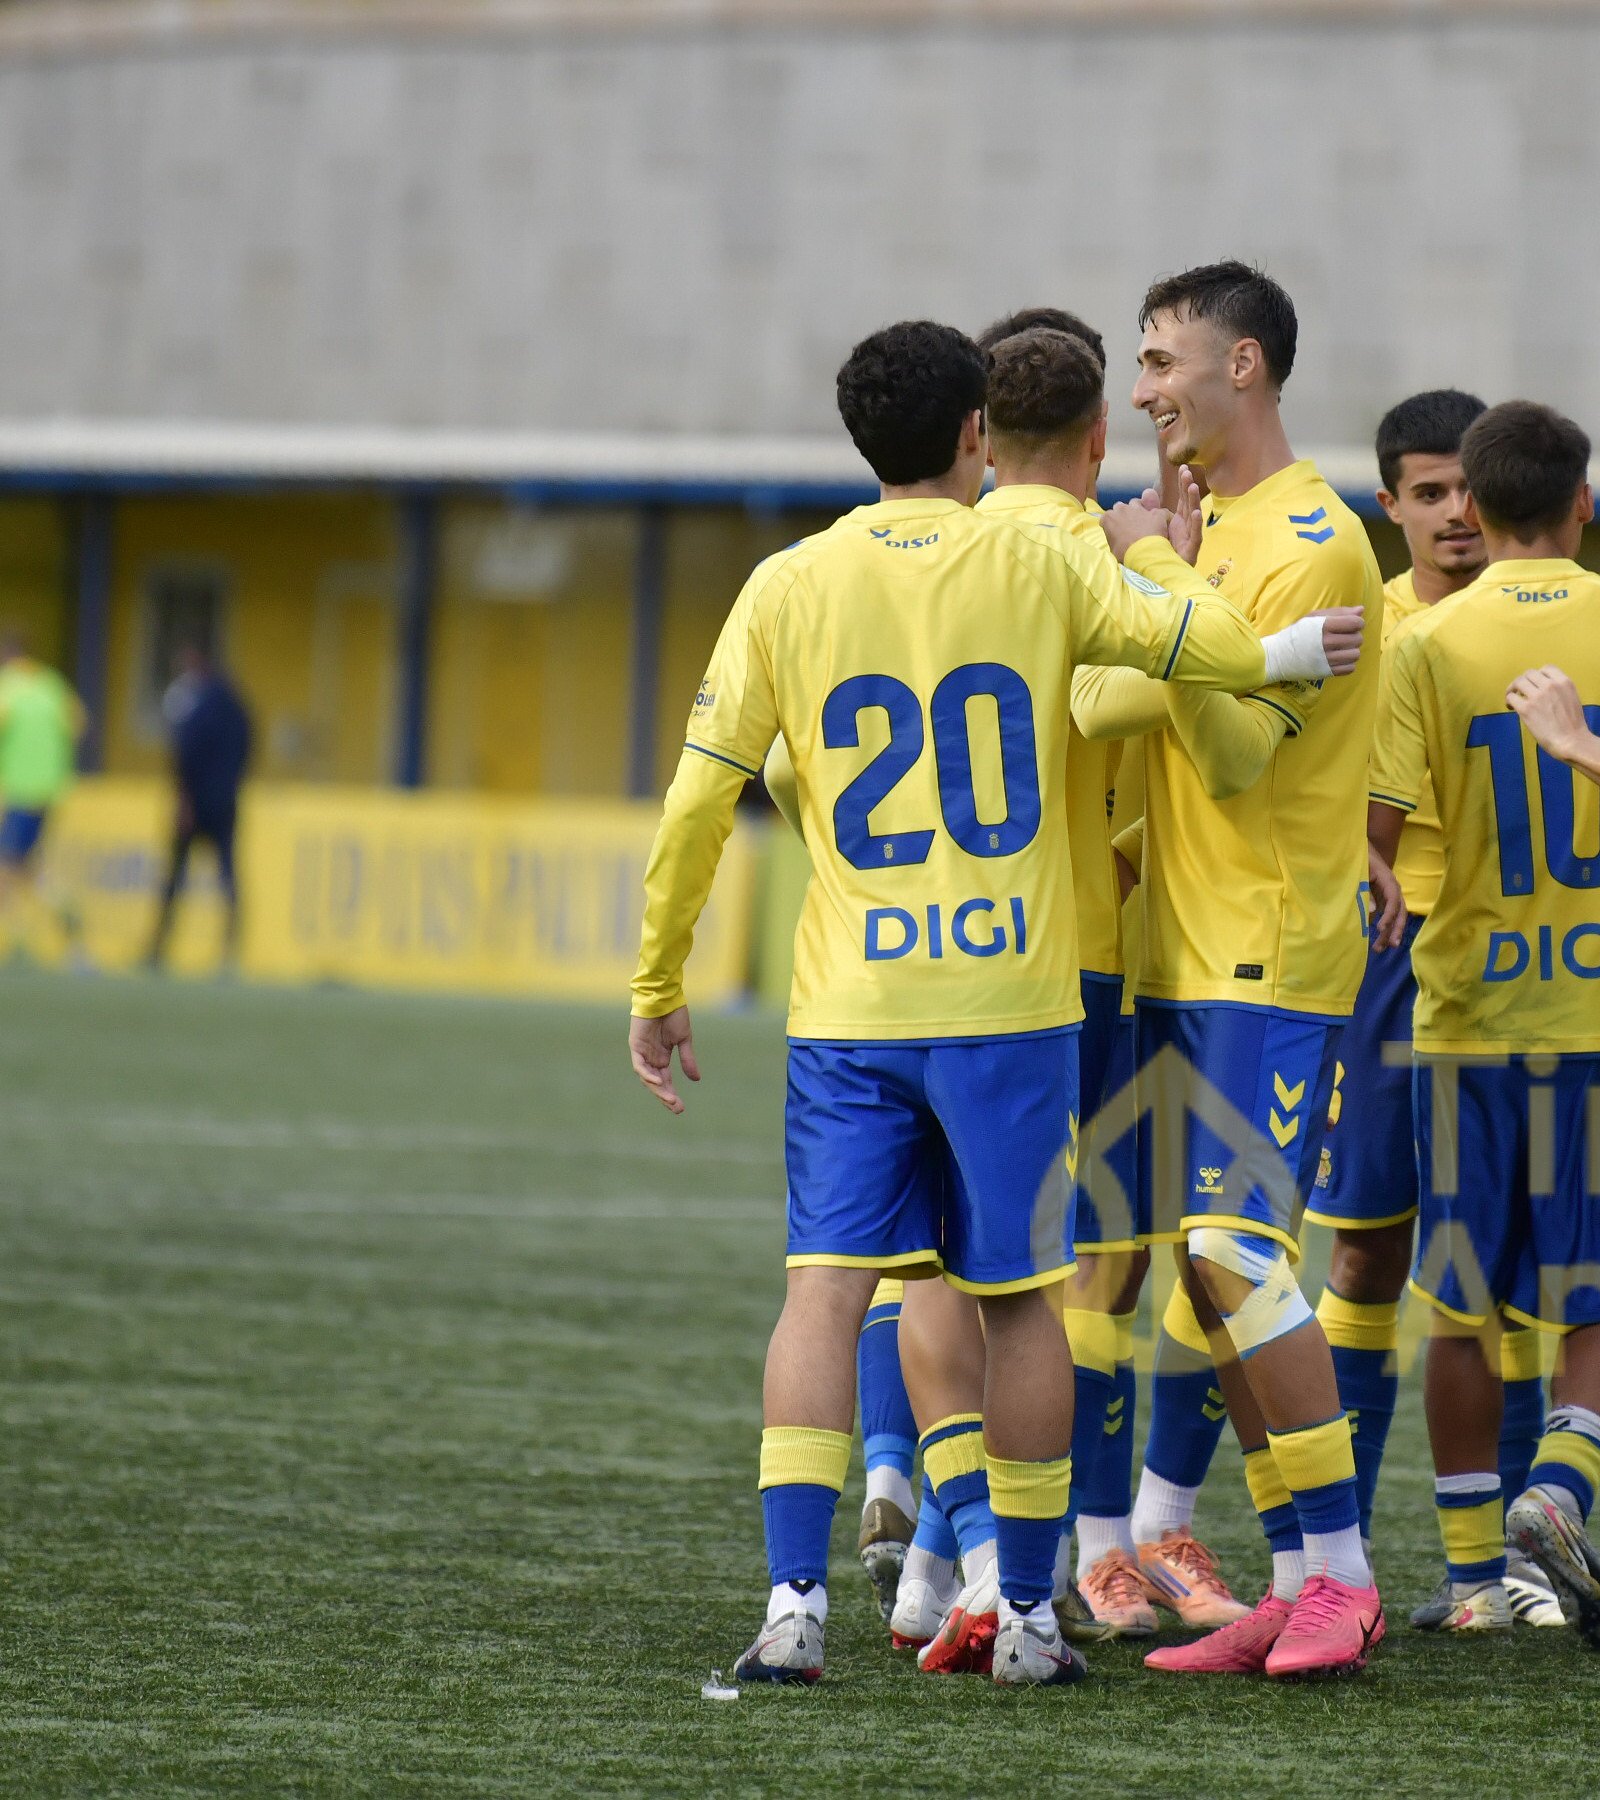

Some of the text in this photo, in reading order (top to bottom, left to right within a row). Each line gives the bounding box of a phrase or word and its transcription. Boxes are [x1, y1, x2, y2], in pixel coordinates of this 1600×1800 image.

[822, 662, 1042, 870] 20
[864, 896, 1027, 962] DIGI
[1195, 1183, 1224, 1195] hummel
